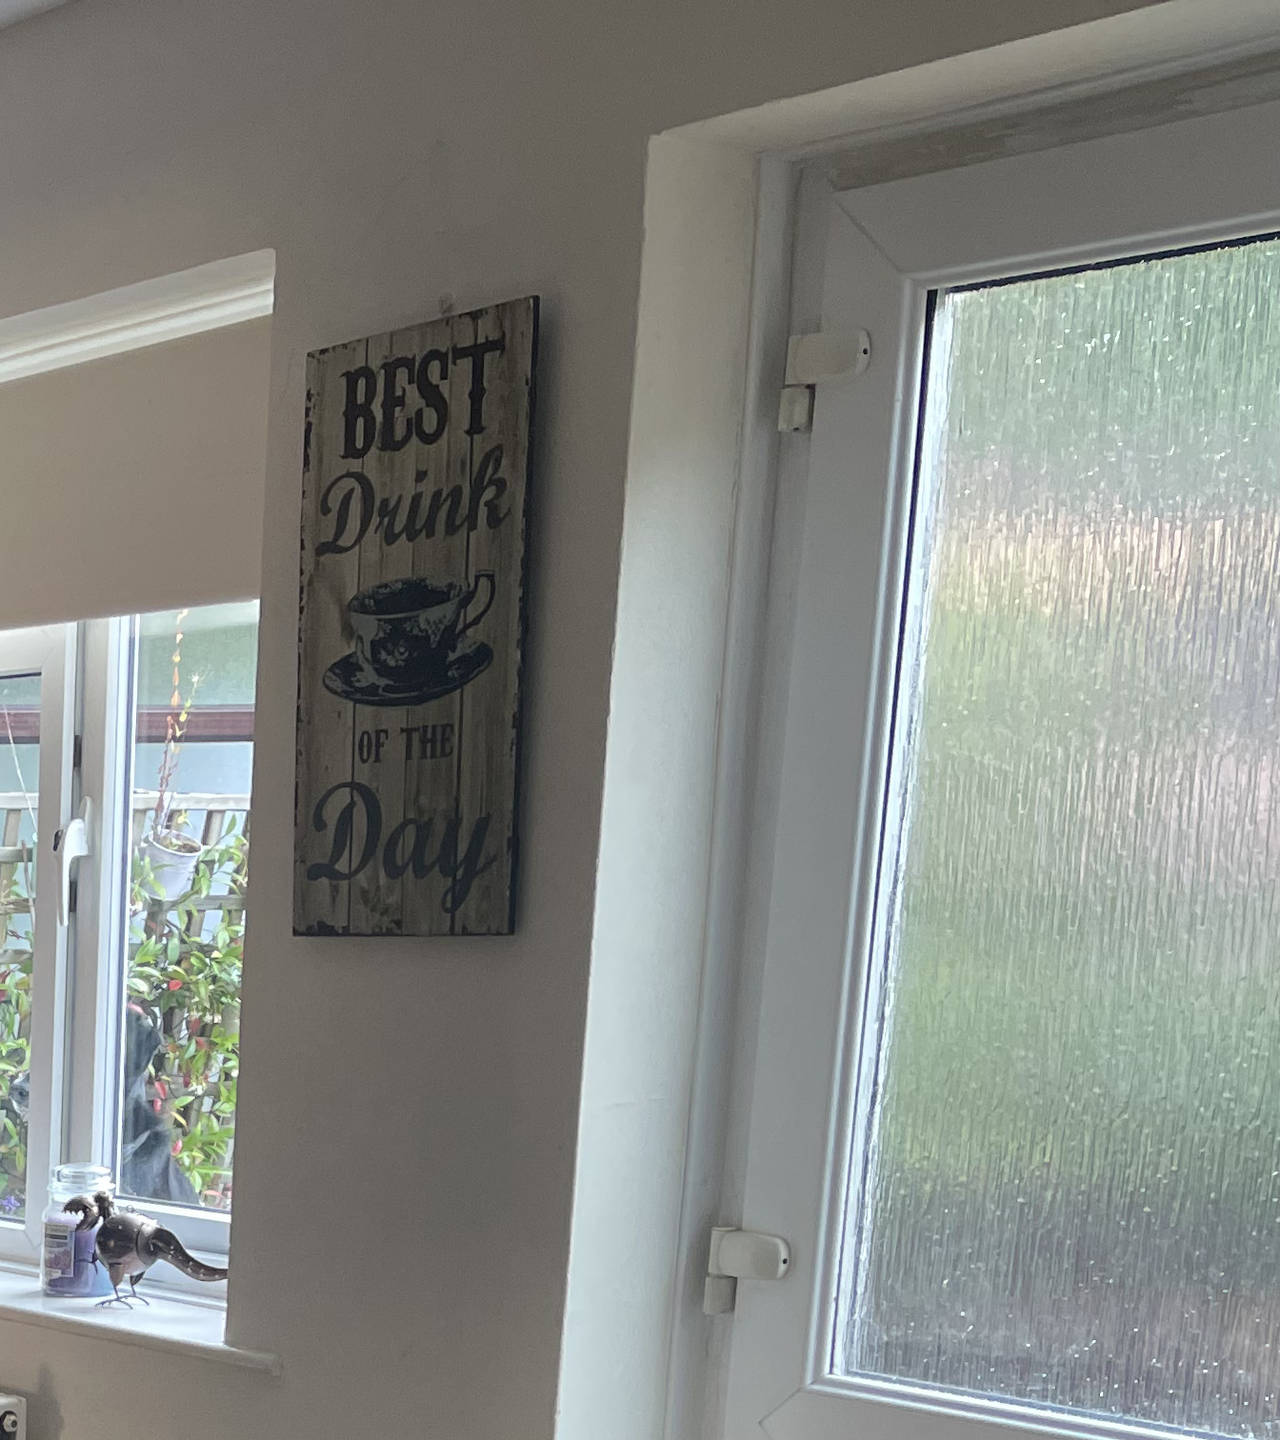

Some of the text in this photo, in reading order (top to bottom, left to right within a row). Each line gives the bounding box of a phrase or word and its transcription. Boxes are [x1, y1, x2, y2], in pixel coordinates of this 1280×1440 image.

[341, 338, 506, 460] BEST
[315, 443, 514, 560] Drink
[357, 722, 456, 764] OF THE
[305, 780, 498, 916] Day
